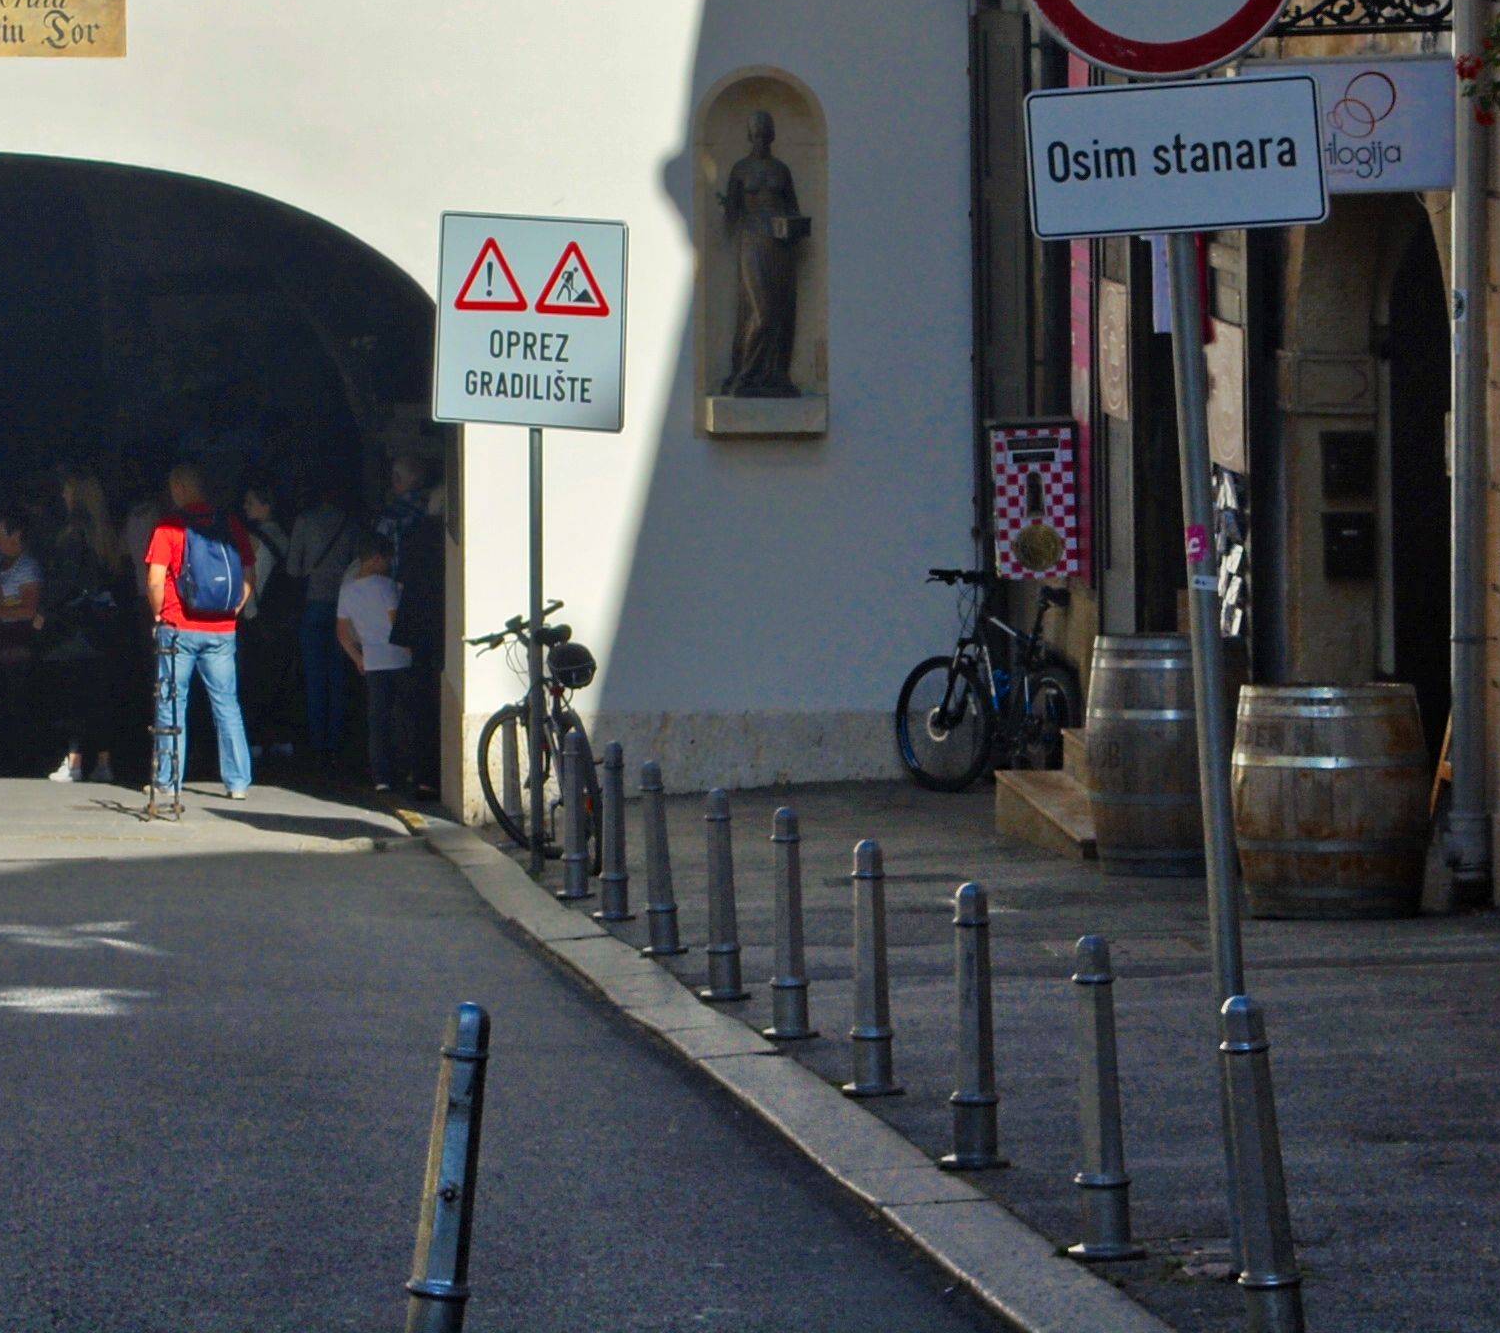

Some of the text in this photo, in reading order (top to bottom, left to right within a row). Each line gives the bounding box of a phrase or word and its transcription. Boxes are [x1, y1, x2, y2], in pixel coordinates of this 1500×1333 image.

[41, 9, 101, 50] Tor
[1047, 133, 1297, 183] Osim stanara
[489, 329, 570, 363] OPREZ
[465, 369, 593, 404] GRADILIŠTE
